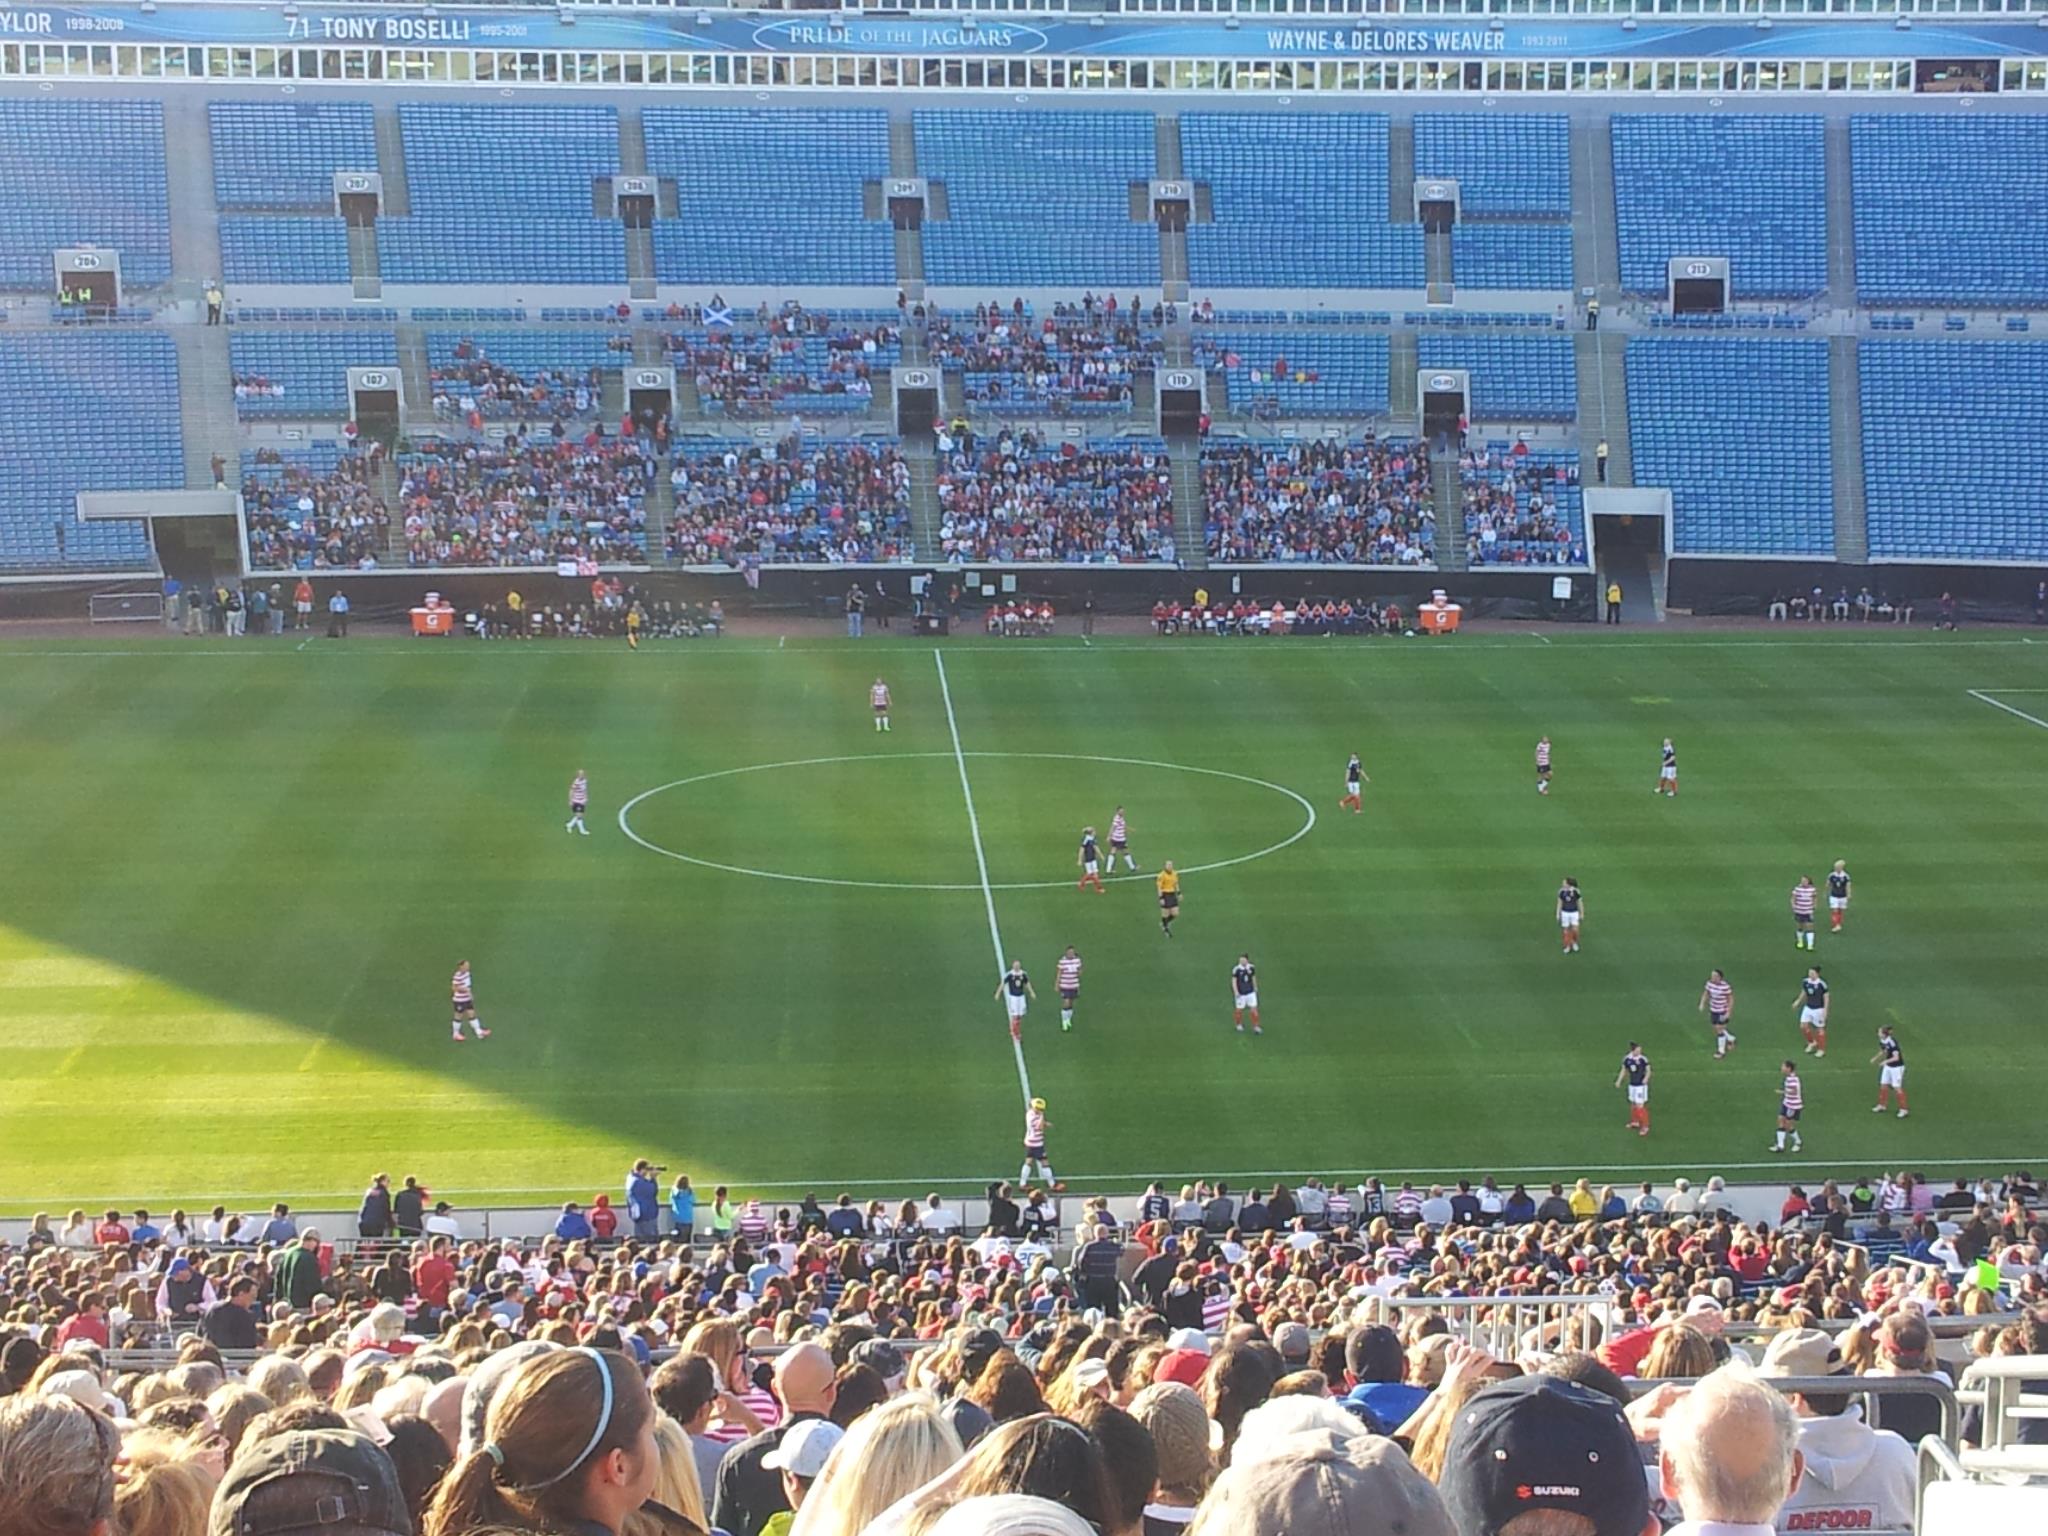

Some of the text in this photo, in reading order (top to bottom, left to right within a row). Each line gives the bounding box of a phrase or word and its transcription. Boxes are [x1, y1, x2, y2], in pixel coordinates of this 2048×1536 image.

[284, 17, 309, 38] 71
[321, 18, 378, 39] TONY
[386, 19, 469, 40] BOSELLI
[790, 26, 853, 43] PRIDE
[887, 30, 912, 43] THE
[922, 28, 1012, 47] JAGUARS
[1267, 31, 1328, 50] WAYNE
[1334, 32, 1345, 50] &
[1352, 31, 1428, 50] DELORES
[1434, 32, 1505, 51] WEAVER
[350, 179, 366, 188] 207
[77, 257, 97, 266] 206
[1691, 265, 1708, 274] 213
[366, 375, 383, 384] 107
[641, 375, 658, 384] 108
[908, 375, 925, 384] 109
[1172, 376, 1188, 385] 110
[1533, 1486, 1580, 1496] SUZUKI
[1787, 1510, 1872, 1531] DEFOOR
